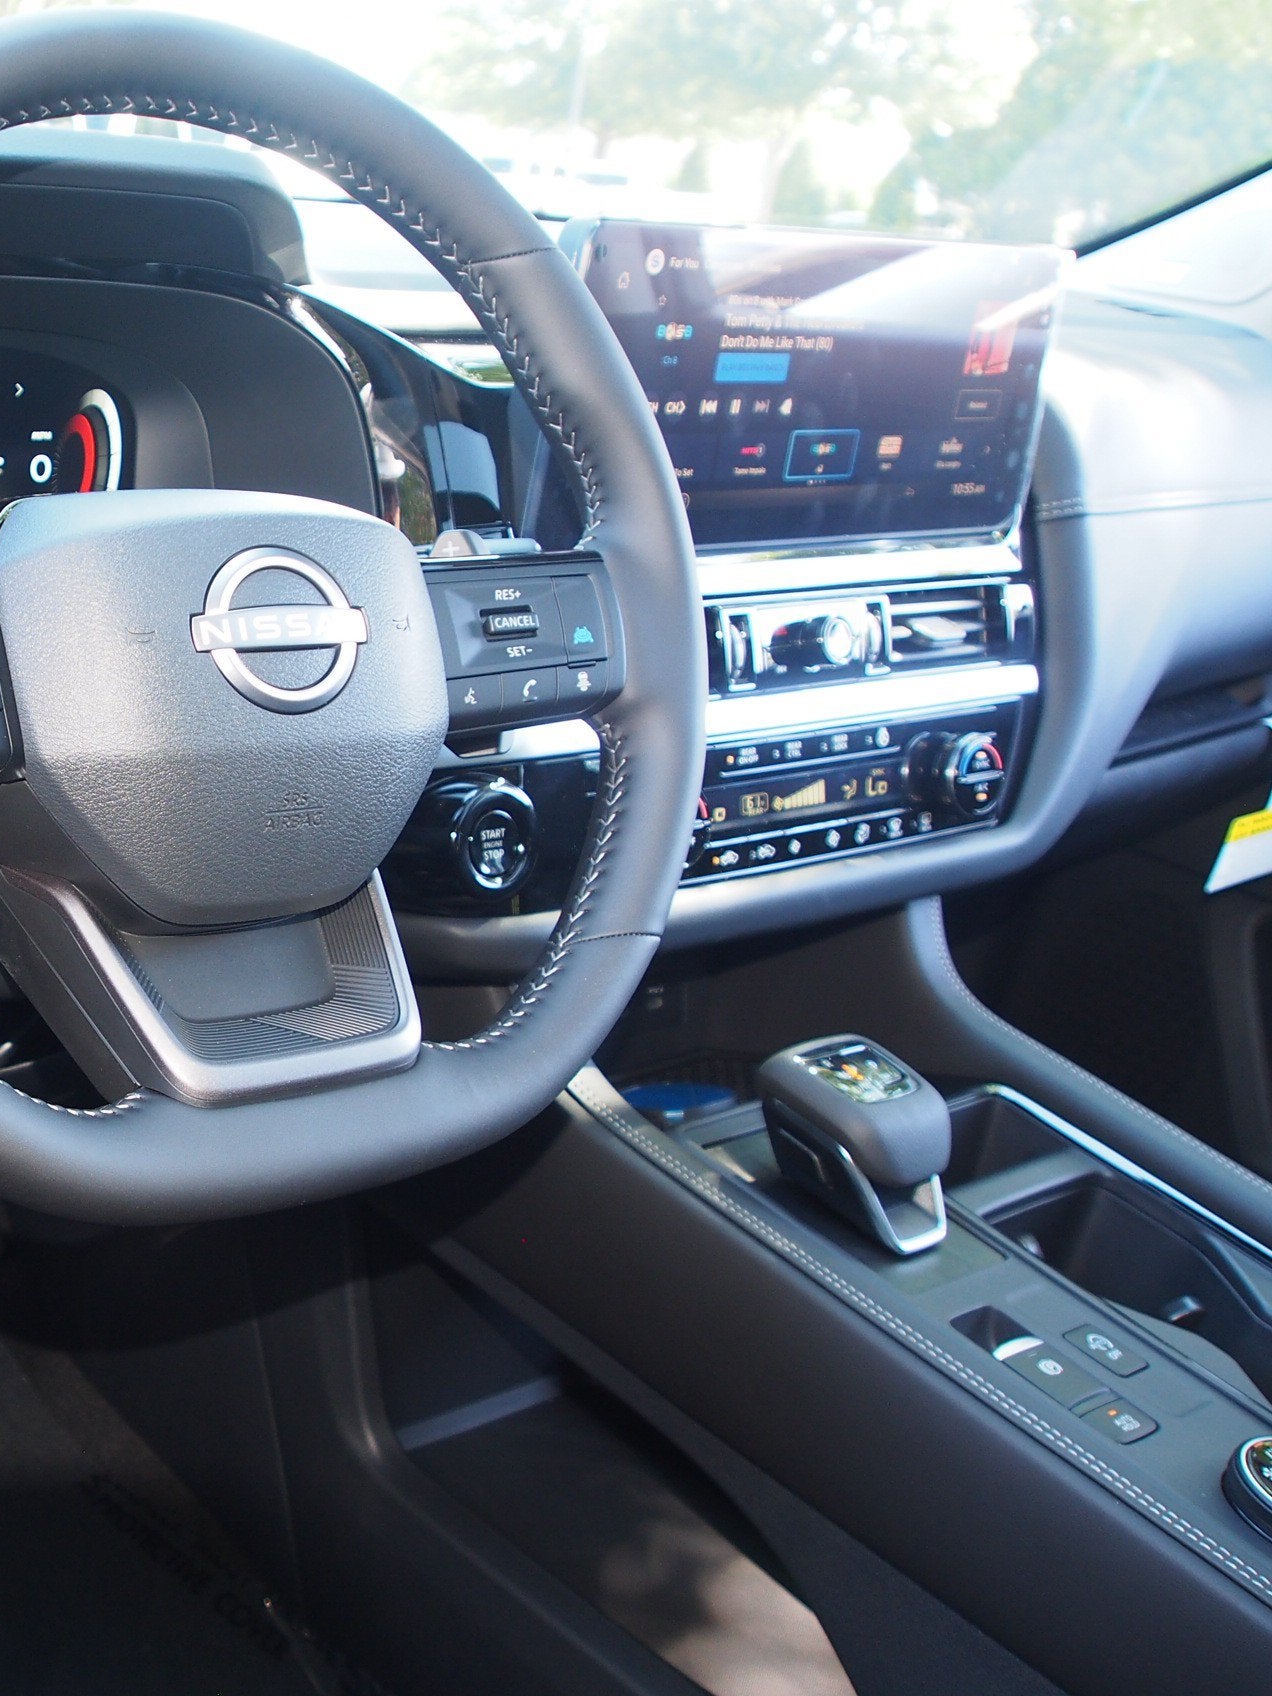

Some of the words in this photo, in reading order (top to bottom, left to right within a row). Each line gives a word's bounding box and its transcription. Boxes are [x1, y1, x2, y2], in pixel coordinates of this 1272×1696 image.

[725, 313, 747, 327] Tom
[721, 334, 744, 348] Don't
[745, 335, 759, 348] Do
[760, 335, 774, 348] Me
[775, 336, 794, 348] Like
[795, 336, 815, 349] That
[29, 454, 53, 483] 0
[494, 588, 522, 601] RES+
[198, 612, 358, 646] NISSA
[493, 615, 536, 629] CANCEL
[480, 827, 506, 841] START
[483, 848, 505, 861] STOP
